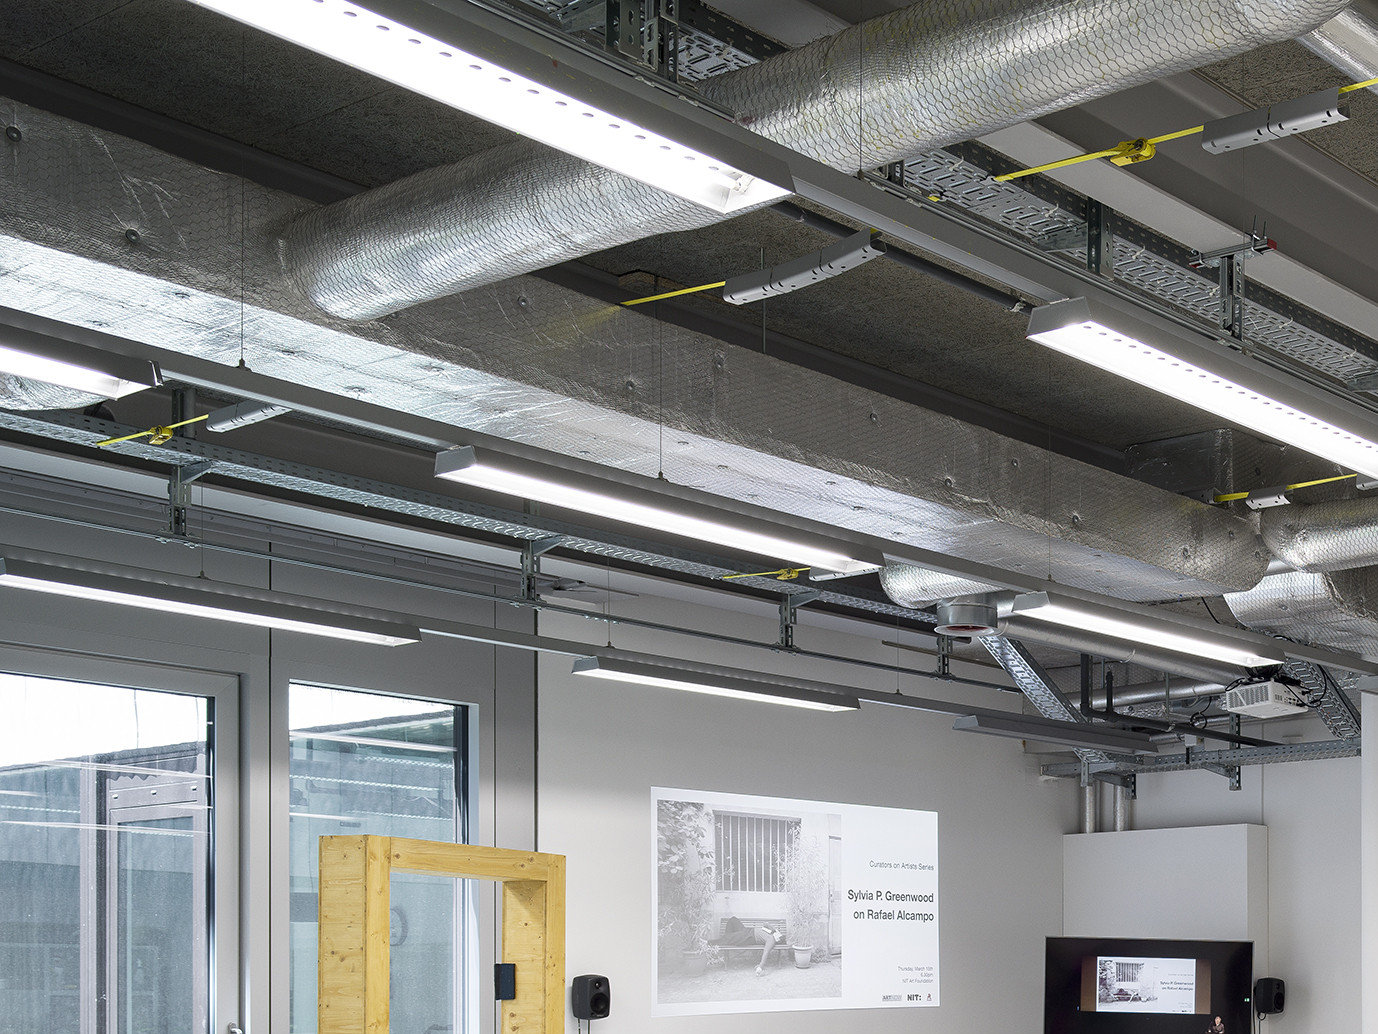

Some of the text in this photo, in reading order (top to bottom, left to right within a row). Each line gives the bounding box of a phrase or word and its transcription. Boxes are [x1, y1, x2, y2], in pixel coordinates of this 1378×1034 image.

[869, 860, 892, 869] Curators
[901, 862, 917, 871] Artists
[918, 862, 934, 871] Series
[847, 889, 934, 903] Sylvia P. Greenwood
[853, 909, 934, 923] on Rafael Alcampo
